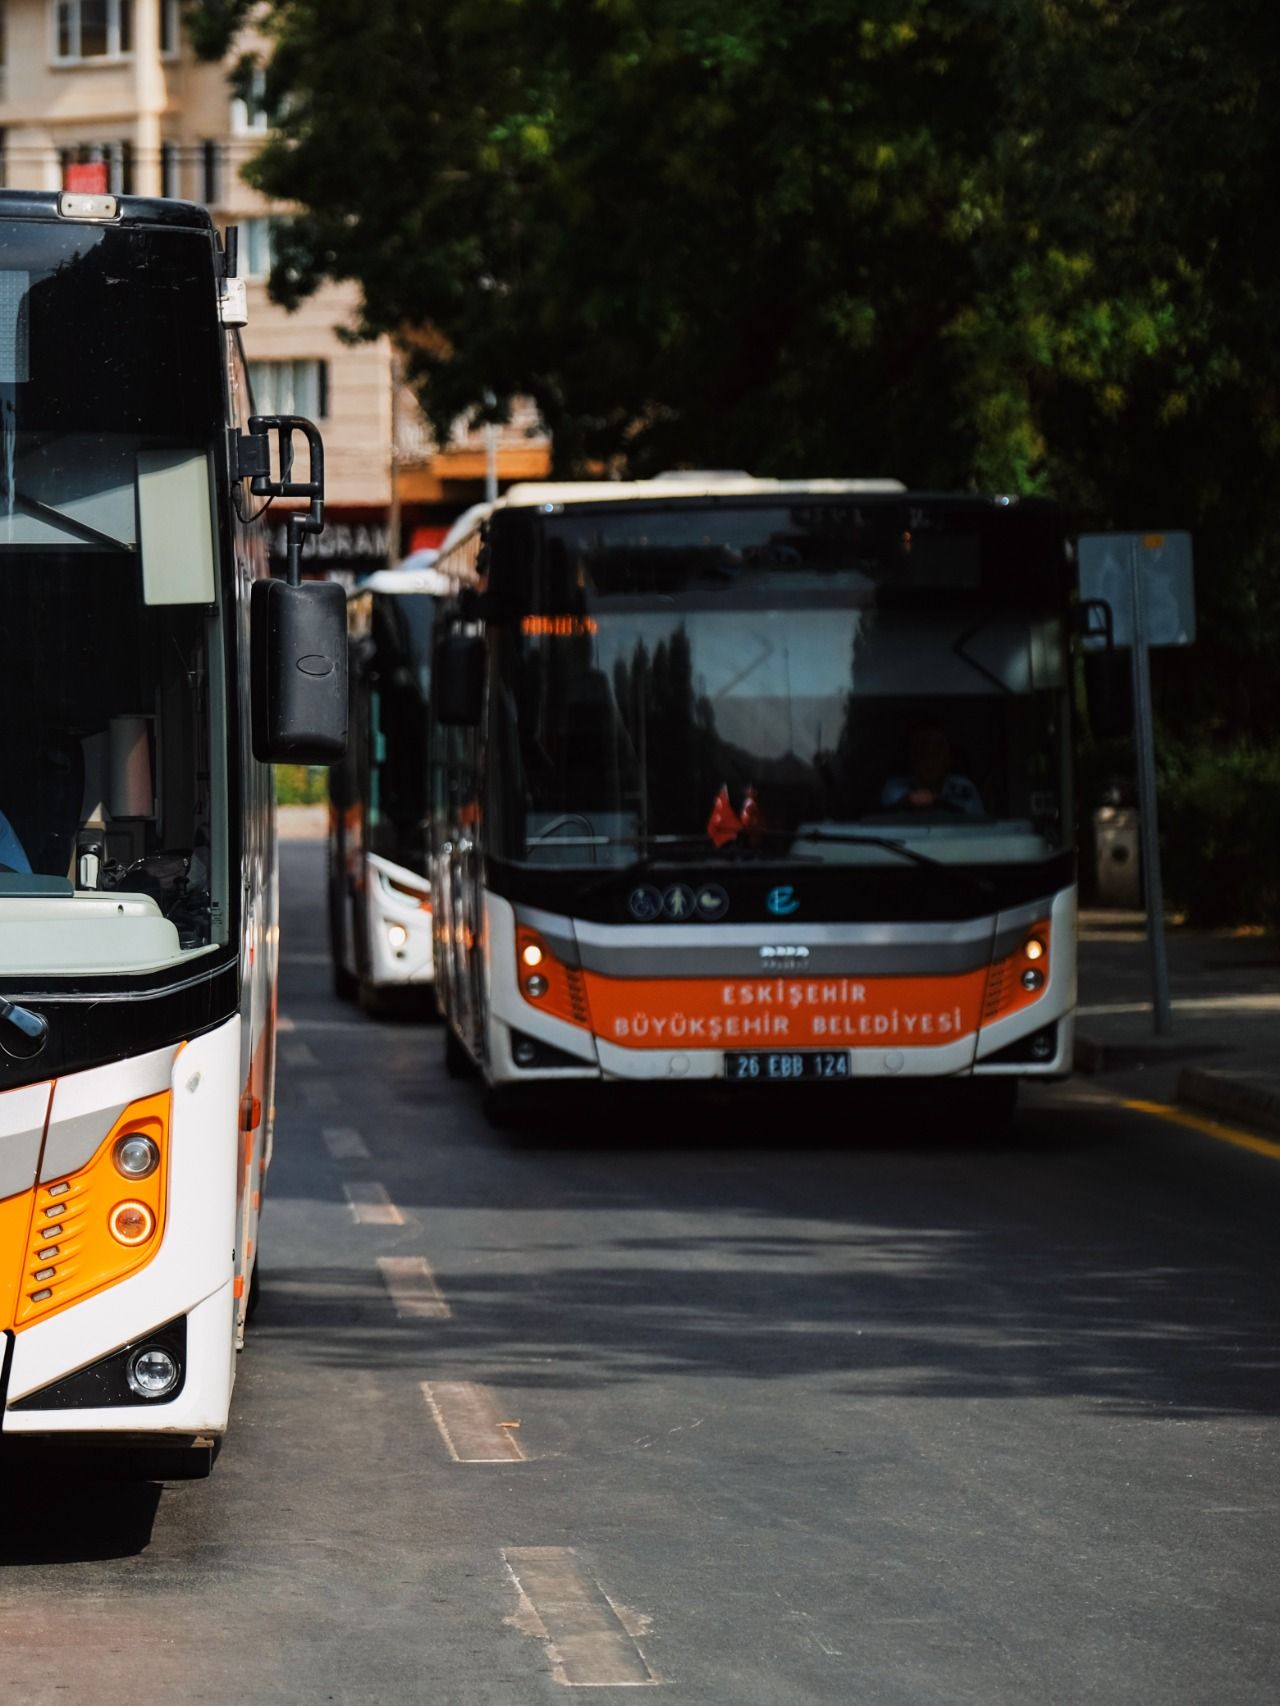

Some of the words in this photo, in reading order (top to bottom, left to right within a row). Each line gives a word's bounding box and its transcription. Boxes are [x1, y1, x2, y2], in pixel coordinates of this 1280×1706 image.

[722, 978, 866, 1008] ESKİŞEHİR
[614, 1011, 790, 1042] BÜYÜKŞEHİR
[812, 1006, 961, 1035] BELEDİYESİ
[738, 1054, 759, 1078] 26
[768, 1054, 803, 1078] EBB
[816, 1054, 848, 1077] 124
